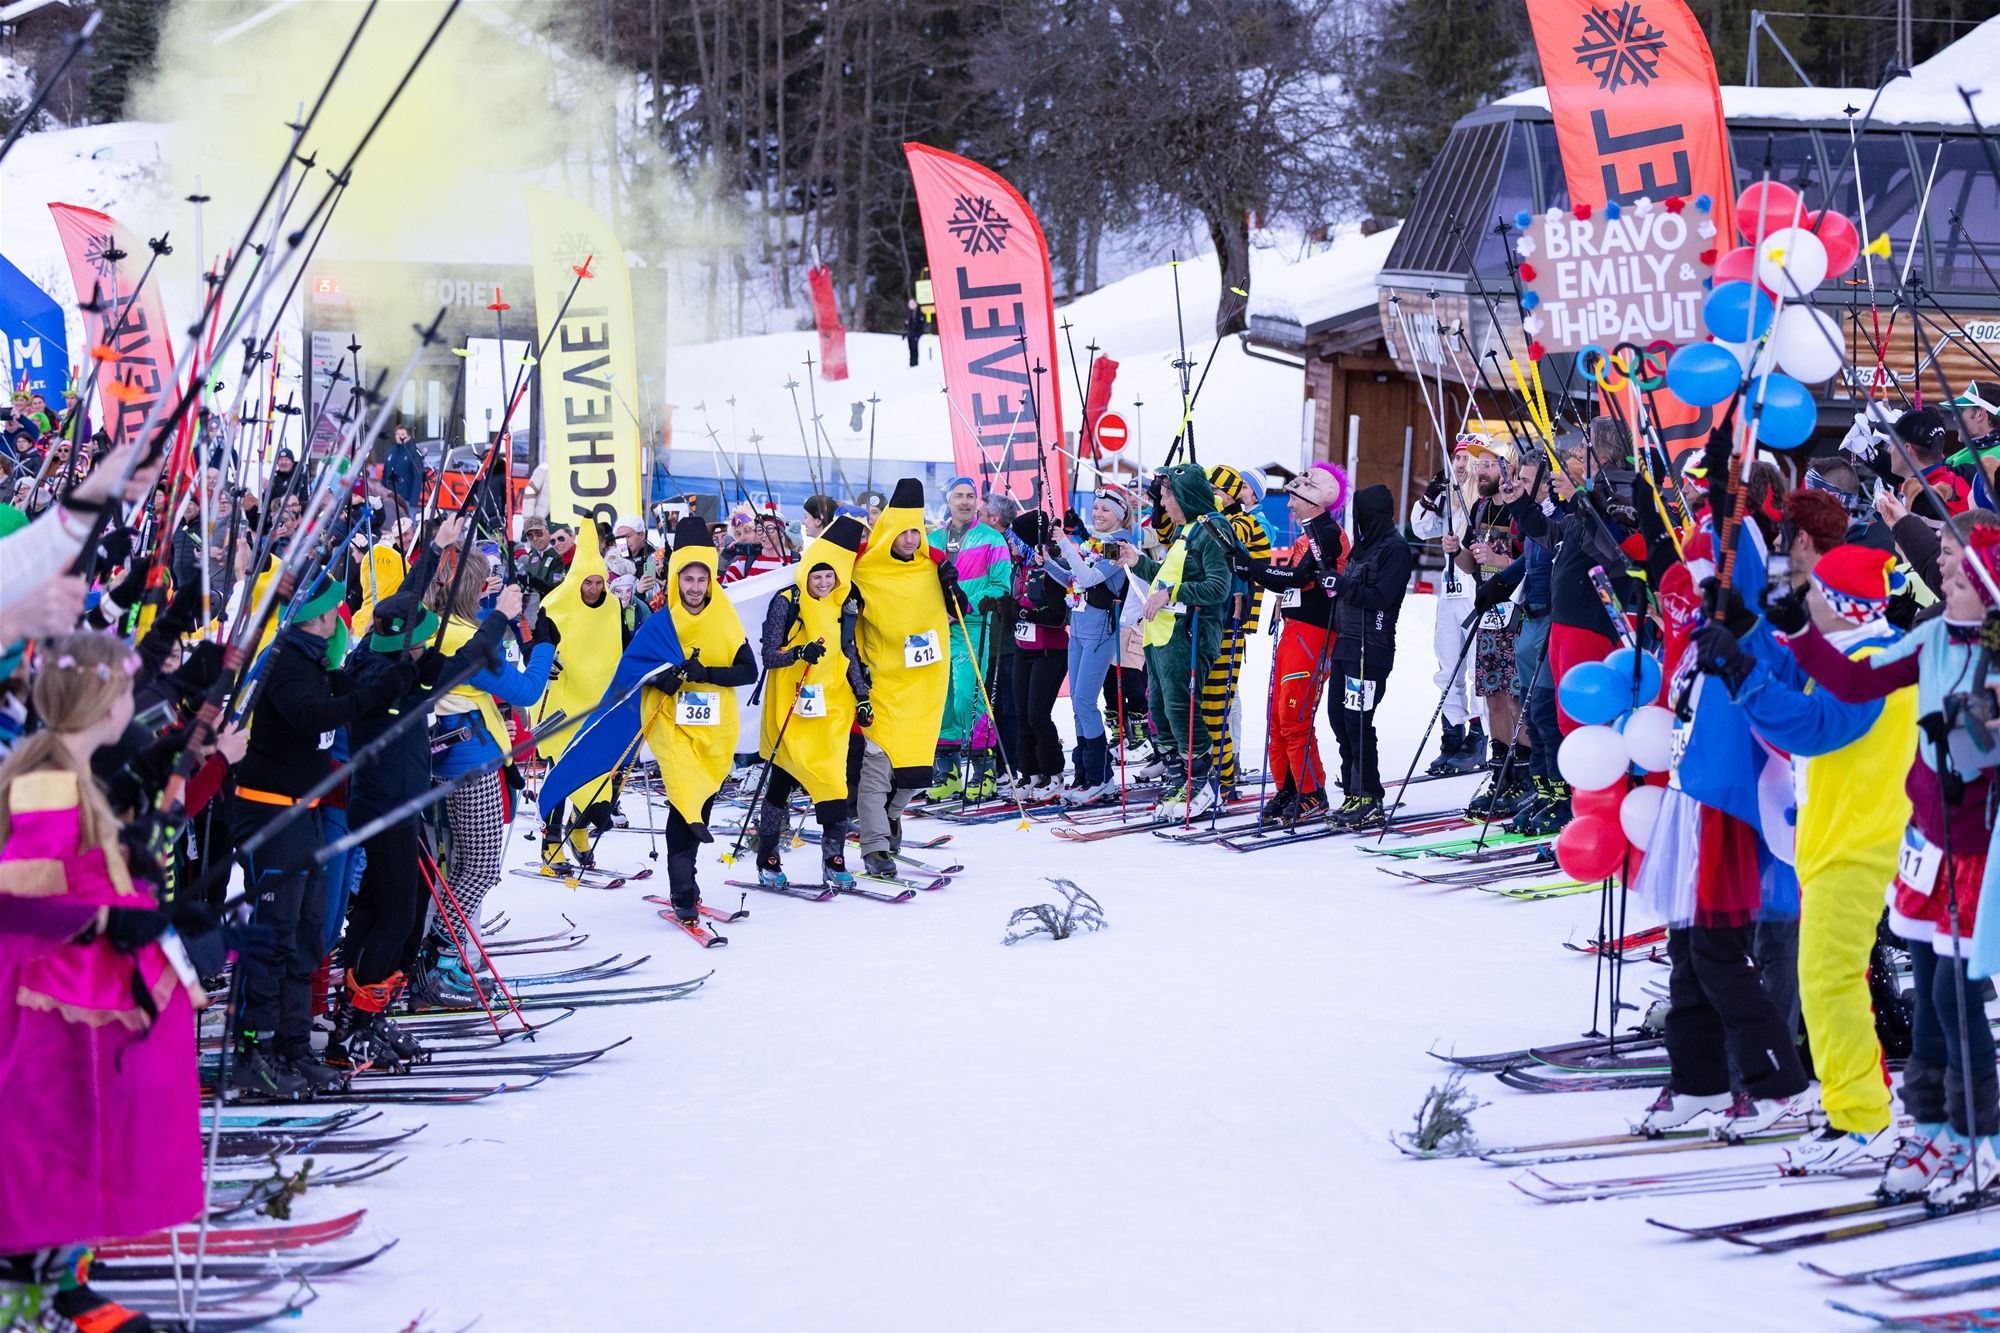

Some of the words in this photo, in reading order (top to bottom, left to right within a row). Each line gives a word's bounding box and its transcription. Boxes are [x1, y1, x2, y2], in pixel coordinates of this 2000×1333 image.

[1544, 212, 1687, 259] BRAVO
[1679, 263, 1697, 281] &
[1968, 325, 2000, 340] 1902
[914, 648, 934, 662] 612
[803, 699, 812, 711] 4
[686, 706, 711, 719] 368
[440, 992, 472, 1002] SCARPA
